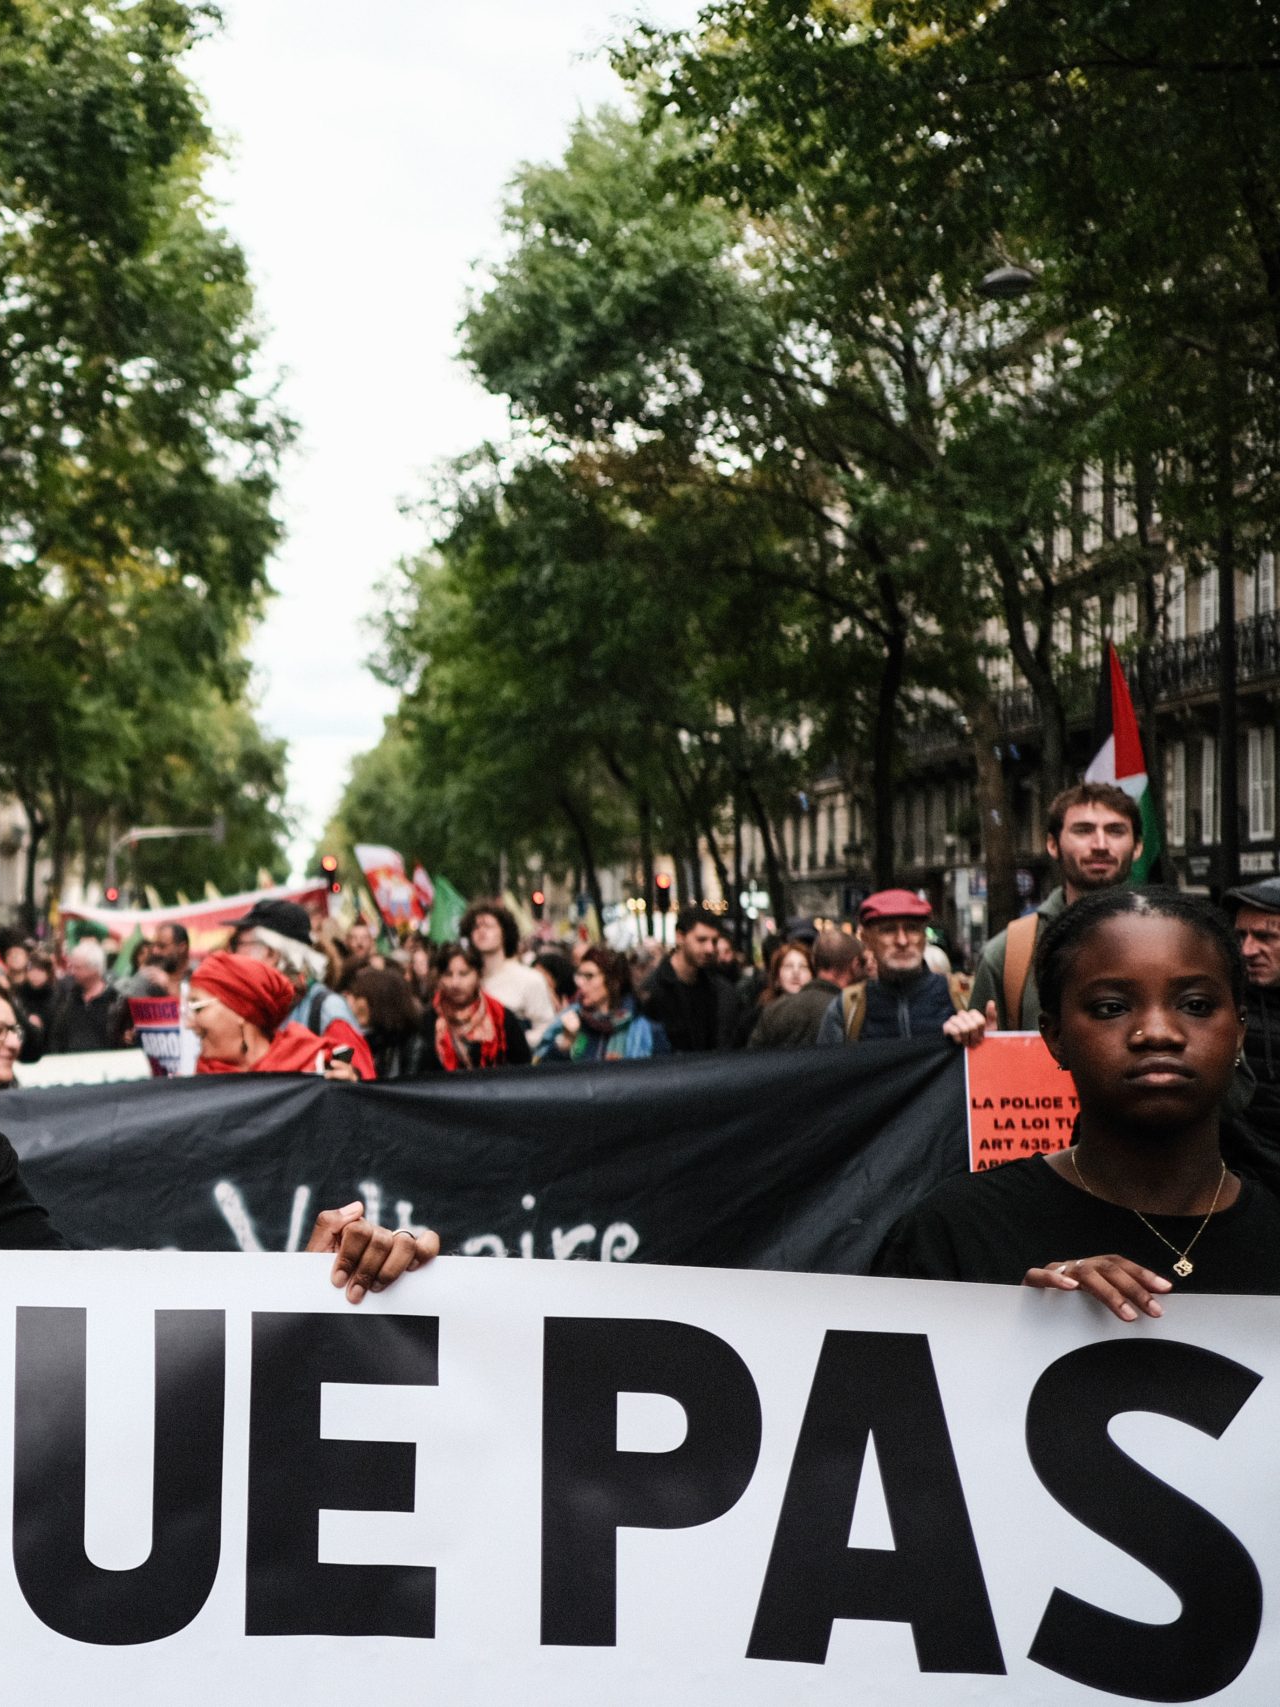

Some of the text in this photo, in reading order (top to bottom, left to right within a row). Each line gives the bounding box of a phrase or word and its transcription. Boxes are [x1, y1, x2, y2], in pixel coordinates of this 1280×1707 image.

[972, 1098, 994, 1109] LA
[1000, 1097, 1063, 1109] POLICE
[994, 1118, 1015, 1130] LA
[1022, 1117, 1050, 1130] LOI
[979, 1138, 1014, 1150] ART
[540, 1315, 1265, 1704] PAS
